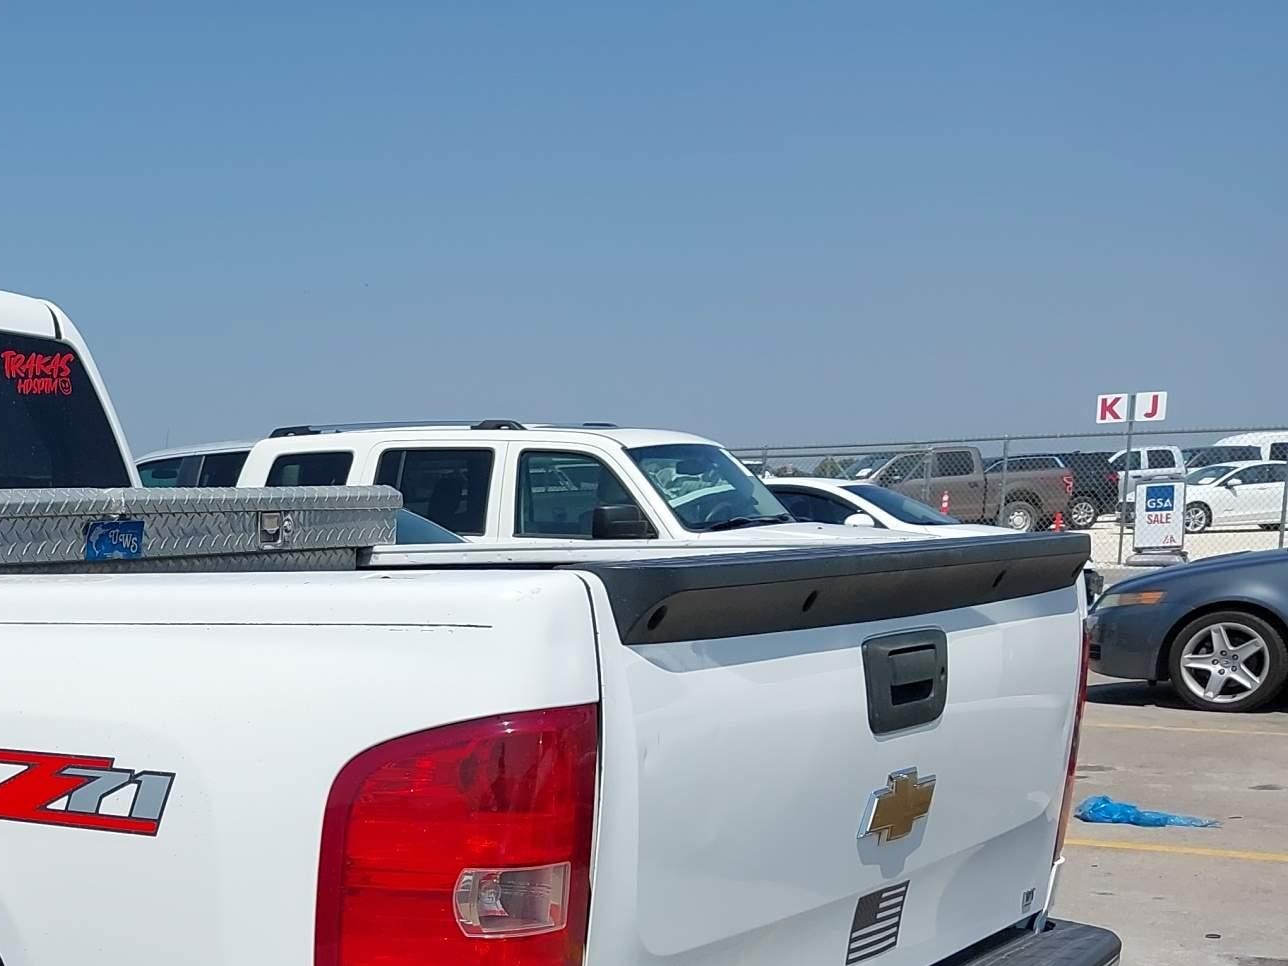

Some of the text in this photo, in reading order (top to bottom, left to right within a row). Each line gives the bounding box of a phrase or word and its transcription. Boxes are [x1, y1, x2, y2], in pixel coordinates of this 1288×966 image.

[0, 350, 75, 379] TRAKAS
[1100, 397, 1122, 421] K
[1144, 394, 1159, 419] J
[1145, 498, 1173, 510] GSA
[1147, 512, 1172, 525] SALE
[108, 529, 139, 553] UWS
